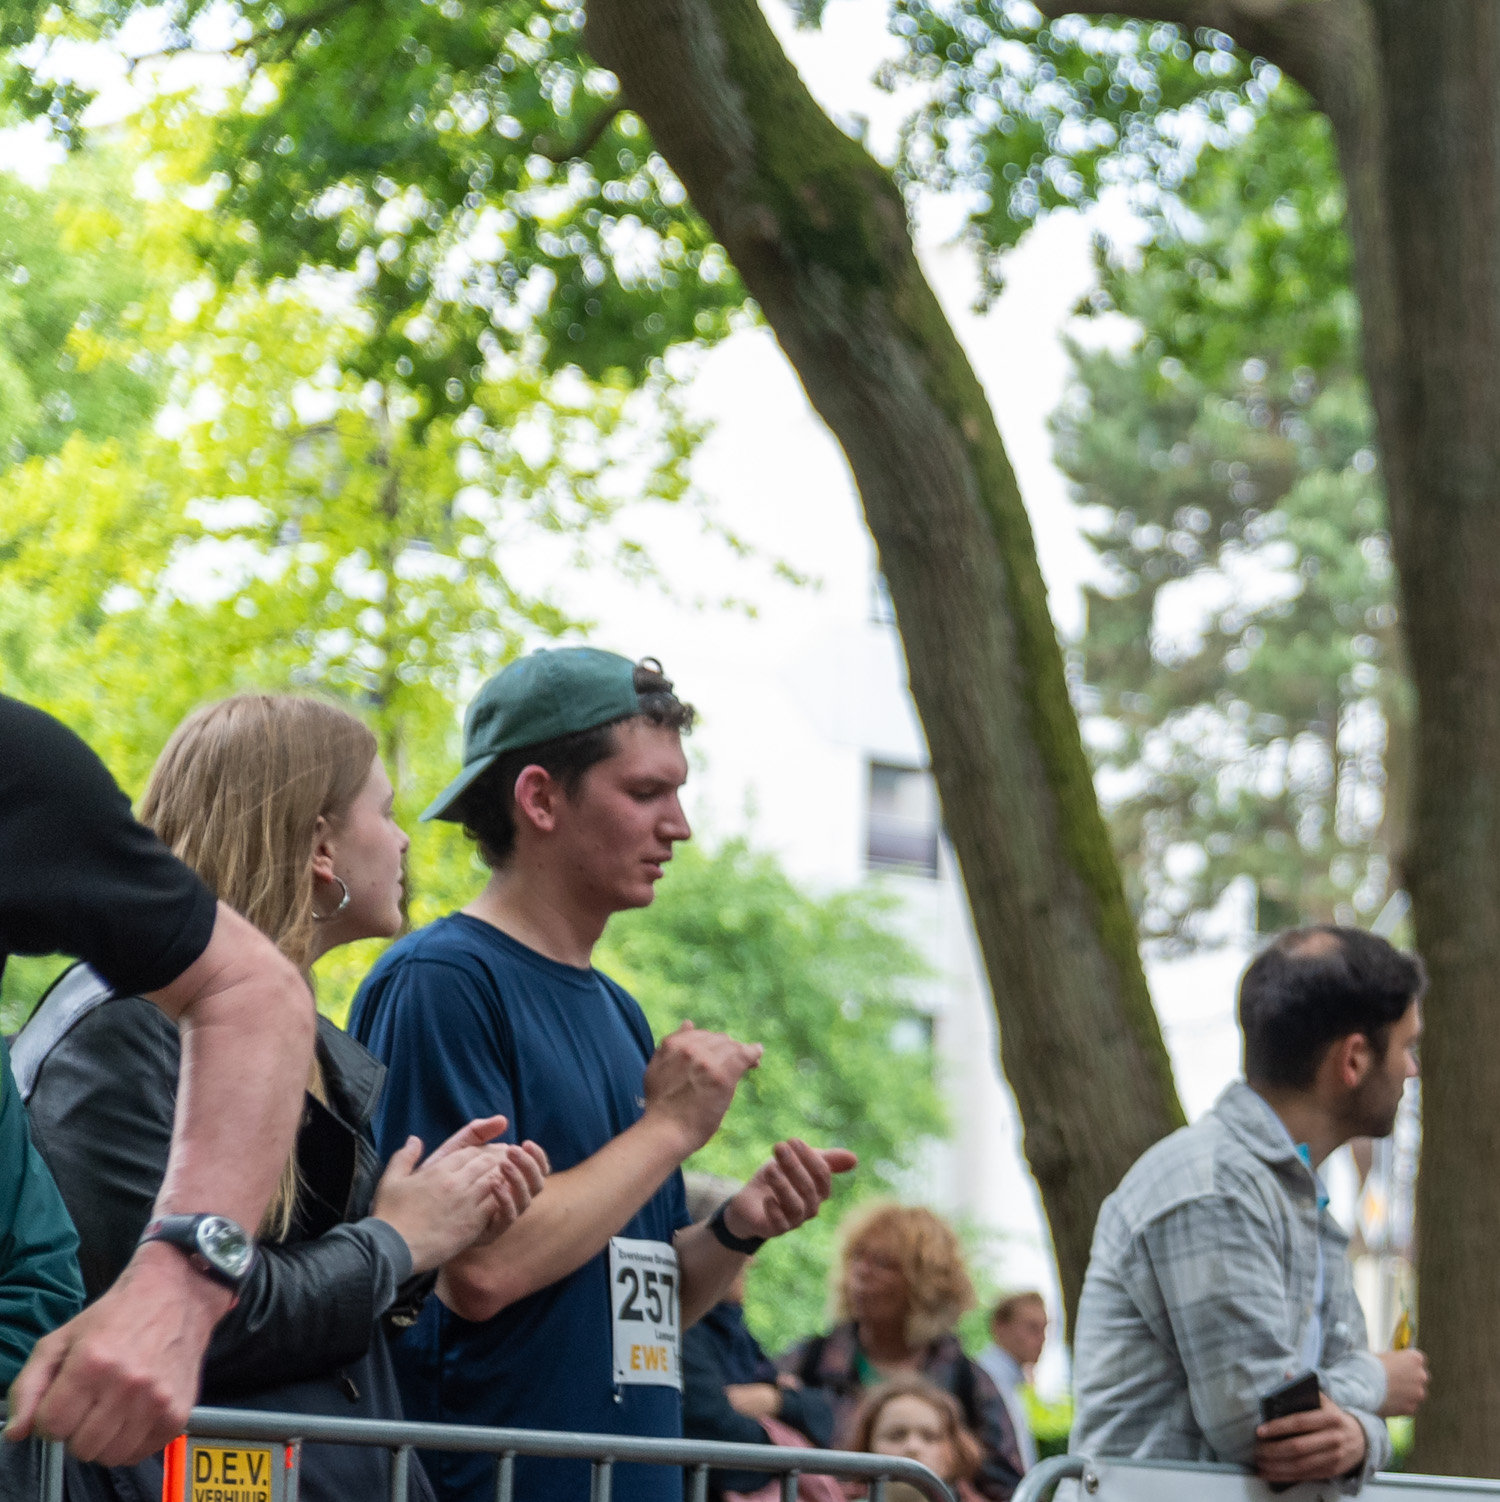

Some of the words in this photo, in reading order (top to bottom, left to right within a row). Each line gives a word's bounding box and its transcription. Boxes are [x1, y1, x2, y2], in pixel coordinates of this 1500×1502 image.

[617, 1267, 674, 1326] 257
[630, 1344, 668, 1372] EWE
[195, 1450, 267, 1486] D.E.V.
